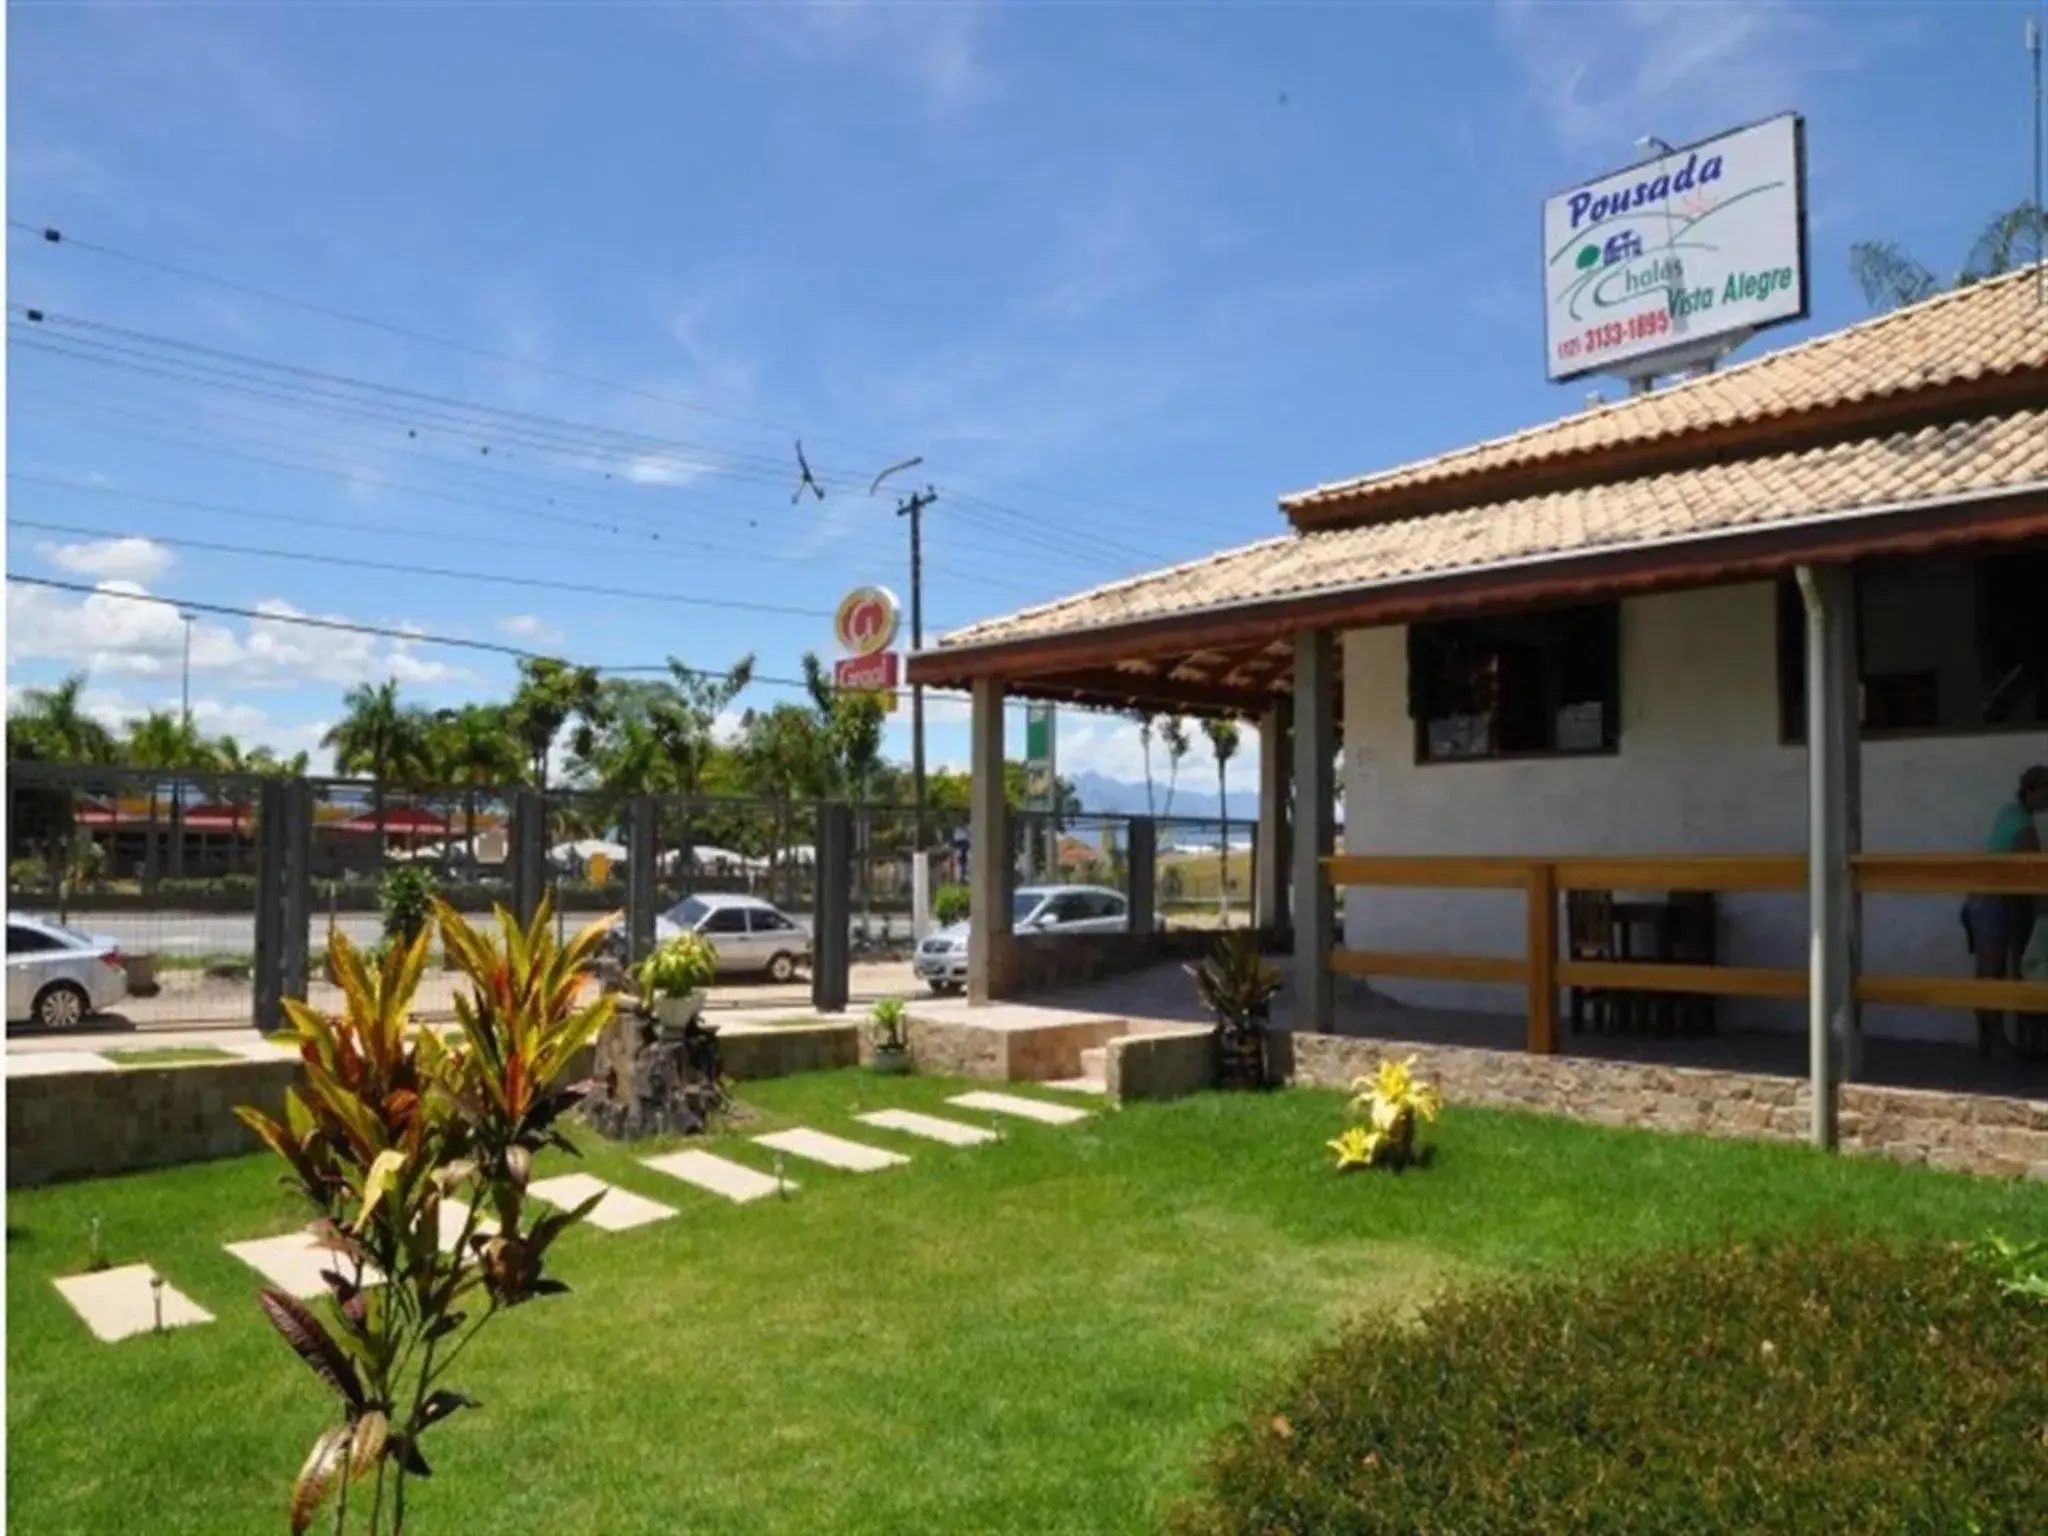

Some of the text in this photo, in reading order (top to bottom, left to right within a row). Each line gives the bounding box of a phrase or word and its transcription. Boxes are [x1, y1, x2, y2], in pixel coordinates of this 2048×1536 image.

[1567, 153, 1722, 228] Pousada
[1666, 266, 1793, 317] Vista Alegre
